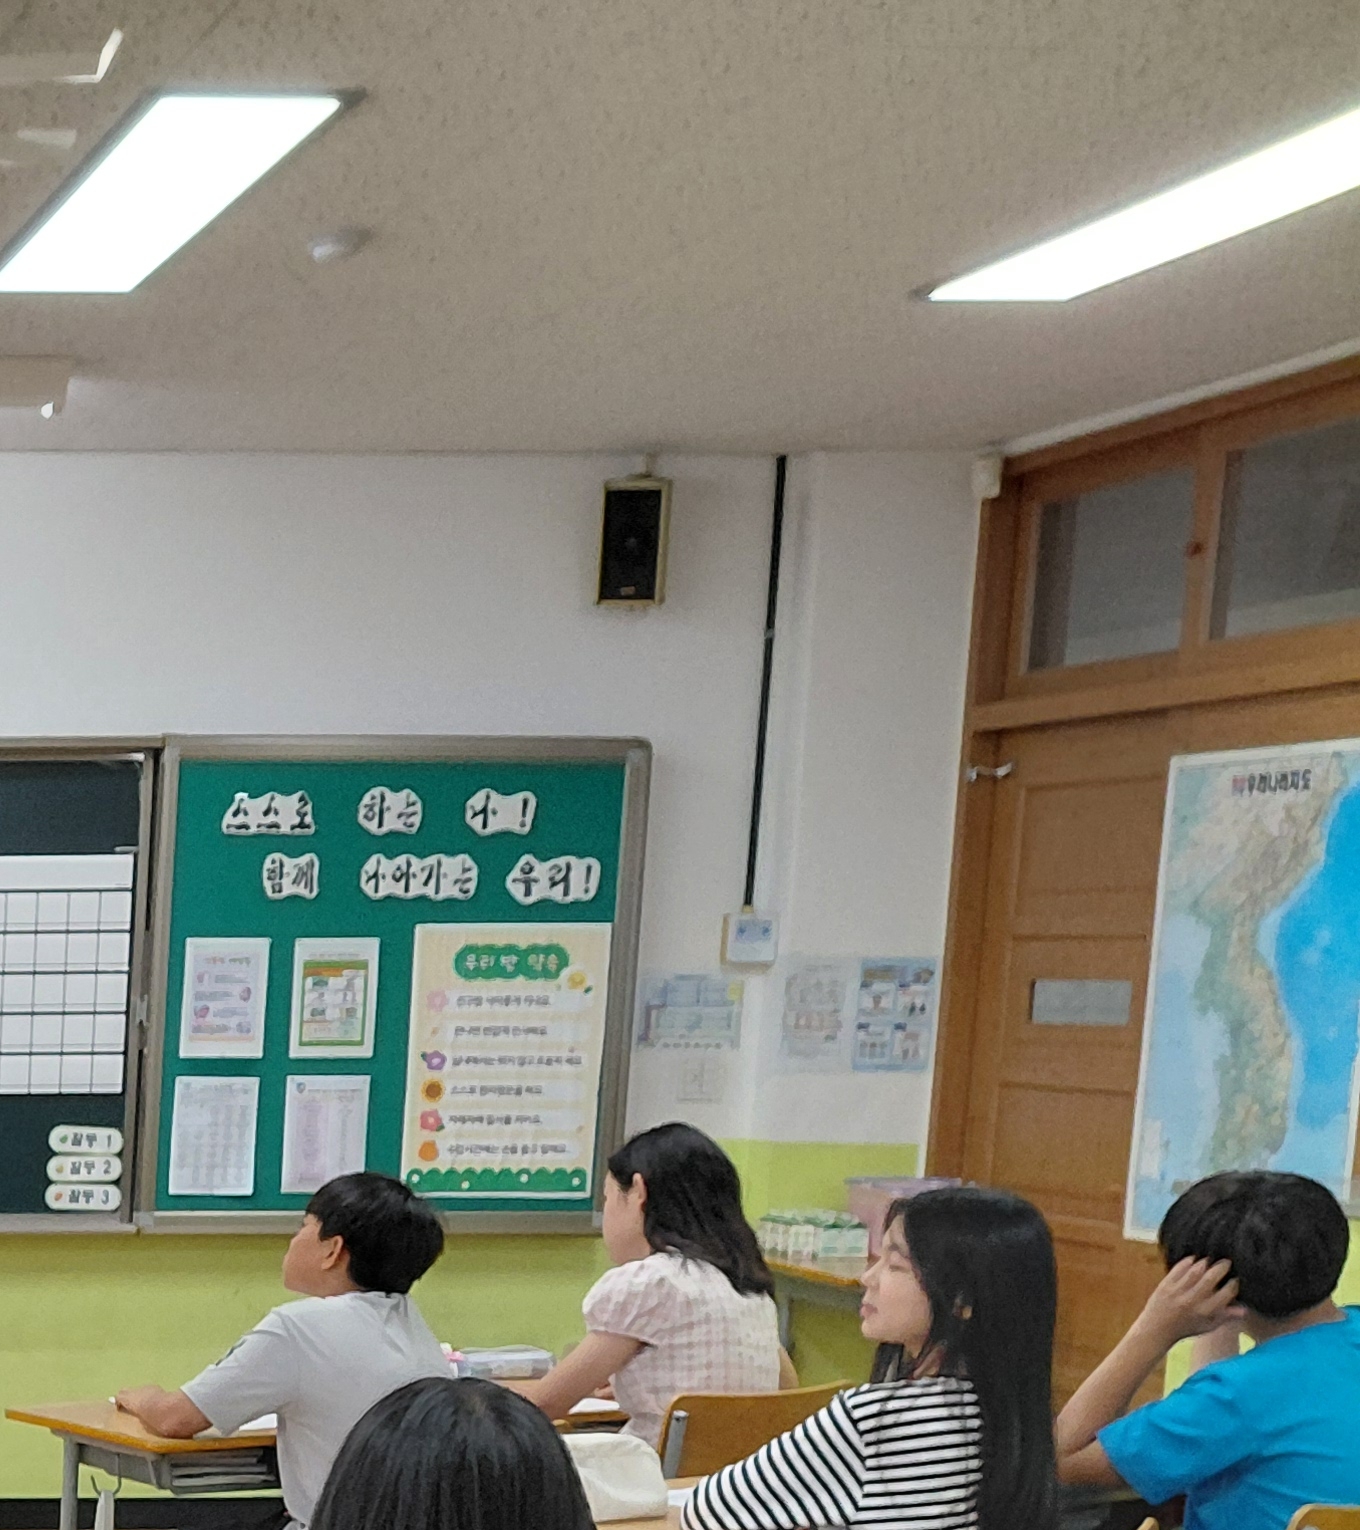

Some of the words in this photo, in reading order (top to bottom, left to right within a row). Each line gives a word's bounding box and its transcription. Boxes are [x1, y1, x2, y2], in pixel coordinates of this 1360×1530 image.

[226, 792, 312, 831] 스스로
[363, 790, 419, 829] 하는
[266, 856, 316, 894] 함께
[363, 856, 473, 895] 나아가는
[511, 860, 593, 898] 우리!
[103, 1159, 112, 1175] 2
[101, 1189, 110, 1205] 3
